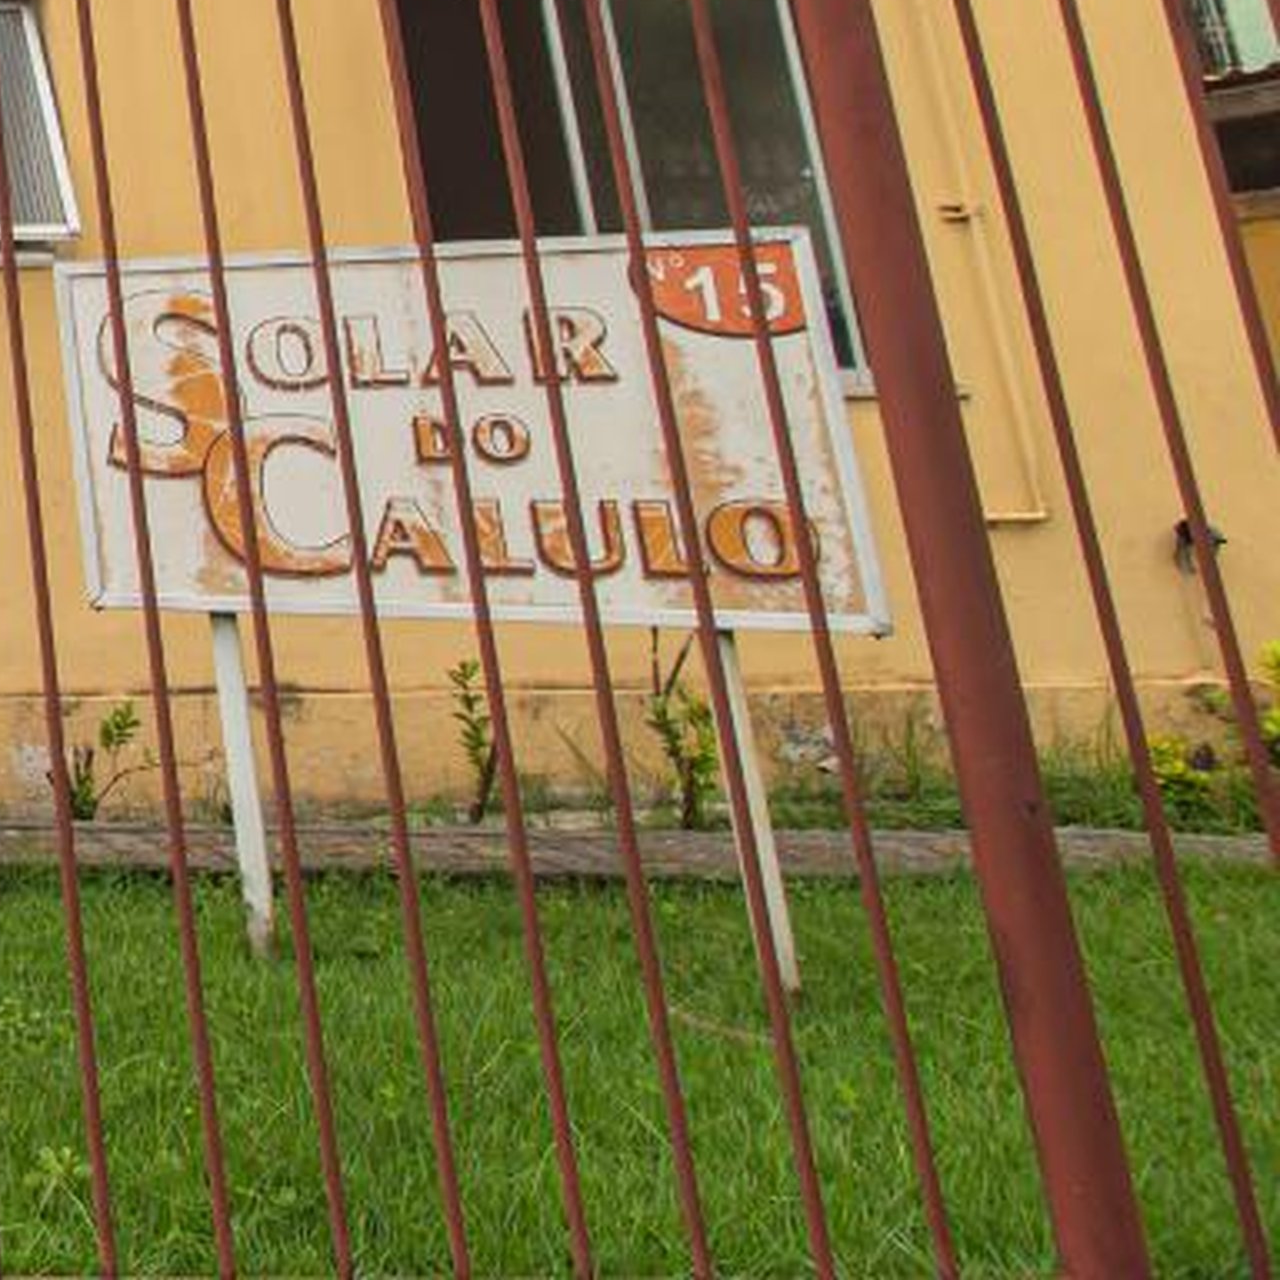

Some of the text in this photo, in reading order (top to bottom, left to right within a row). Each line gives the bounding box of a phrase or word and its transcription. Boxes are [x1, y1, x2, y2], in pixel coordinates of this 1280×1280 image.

[684, 260, 787, 324] 15
[96, 286, 619, 480] SOLAR
[411, 411, 532, 465] DO
